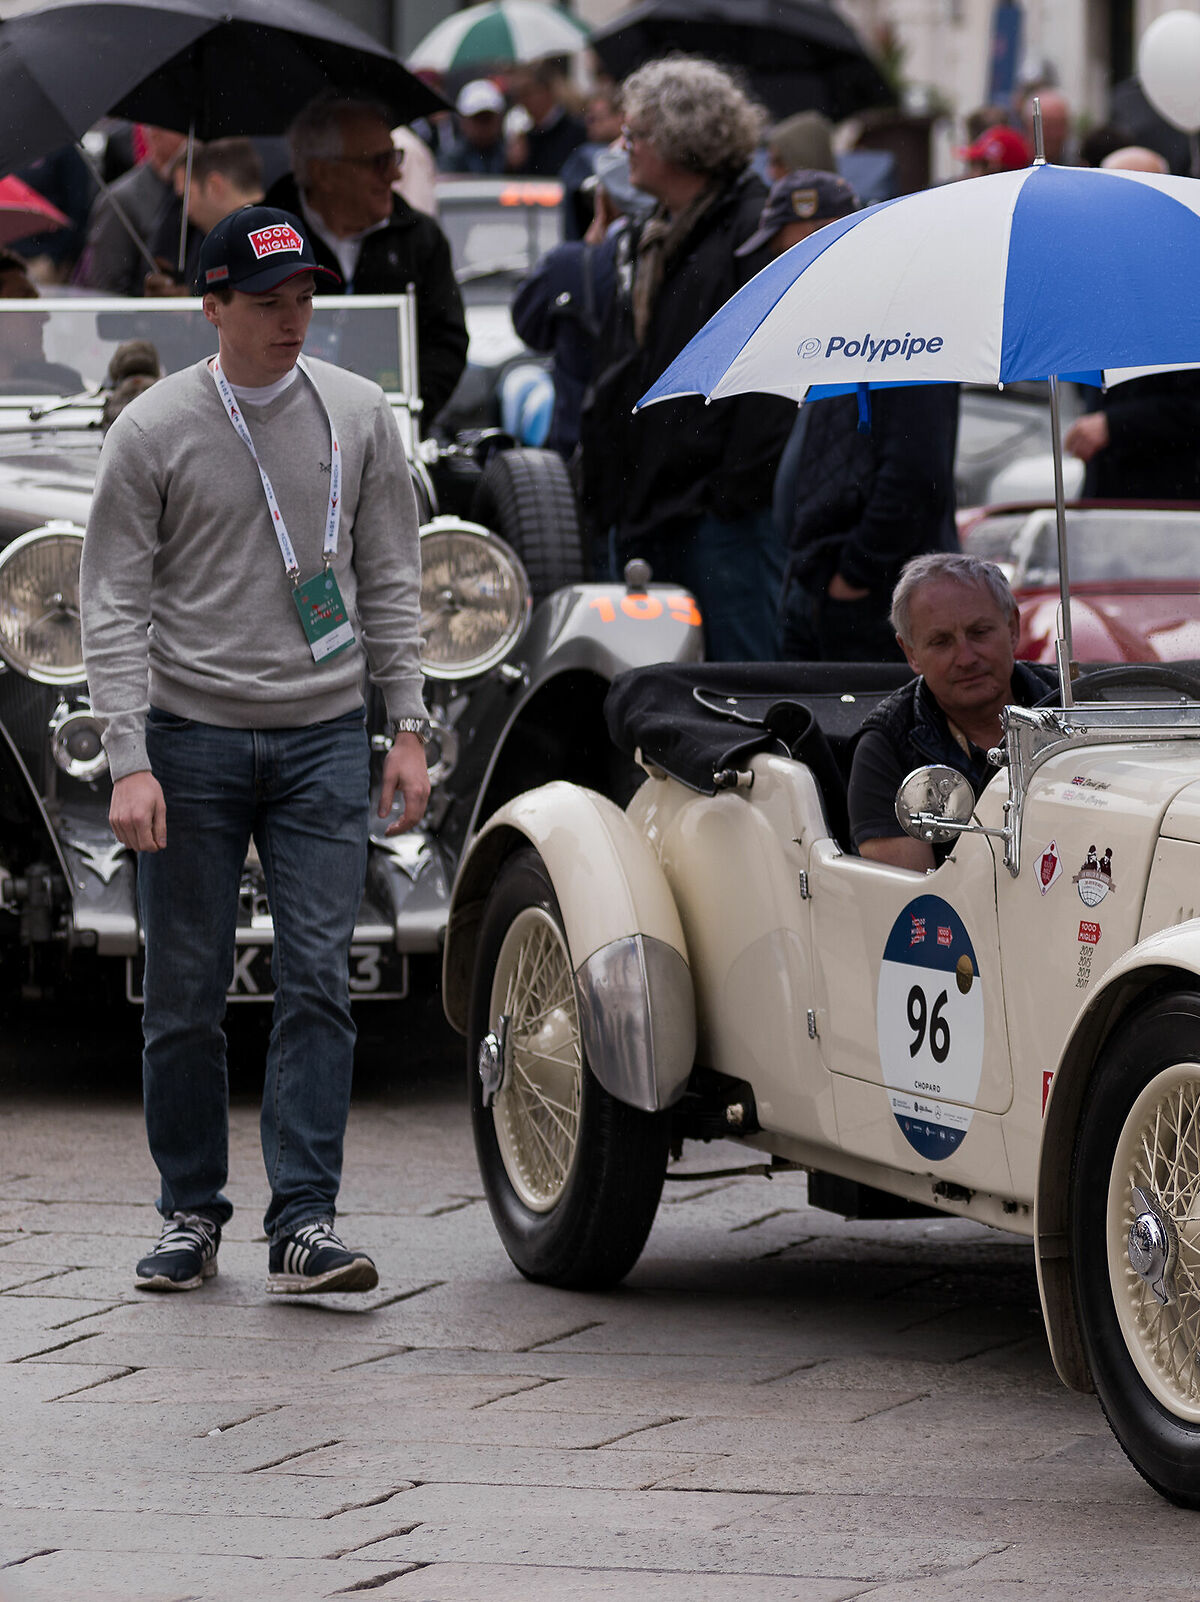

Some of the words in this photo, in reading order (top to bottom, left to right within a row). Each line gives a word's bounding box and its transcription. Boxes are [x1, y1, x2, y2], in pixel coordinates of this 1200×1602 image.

[256, 227, 290, 243] 1000
[258, 238, 298, 254] MIGLIA
[825, 332, 944, 363] Polypipe
[589, 595, 702, 627] 105
[1081, 923, 1097, 932] 1000
[1079, 932, 1097, 942] MIGLIA
[907, 985, 951, 1064] 96
[914, 1081, 941, 1093] CHOPARD
